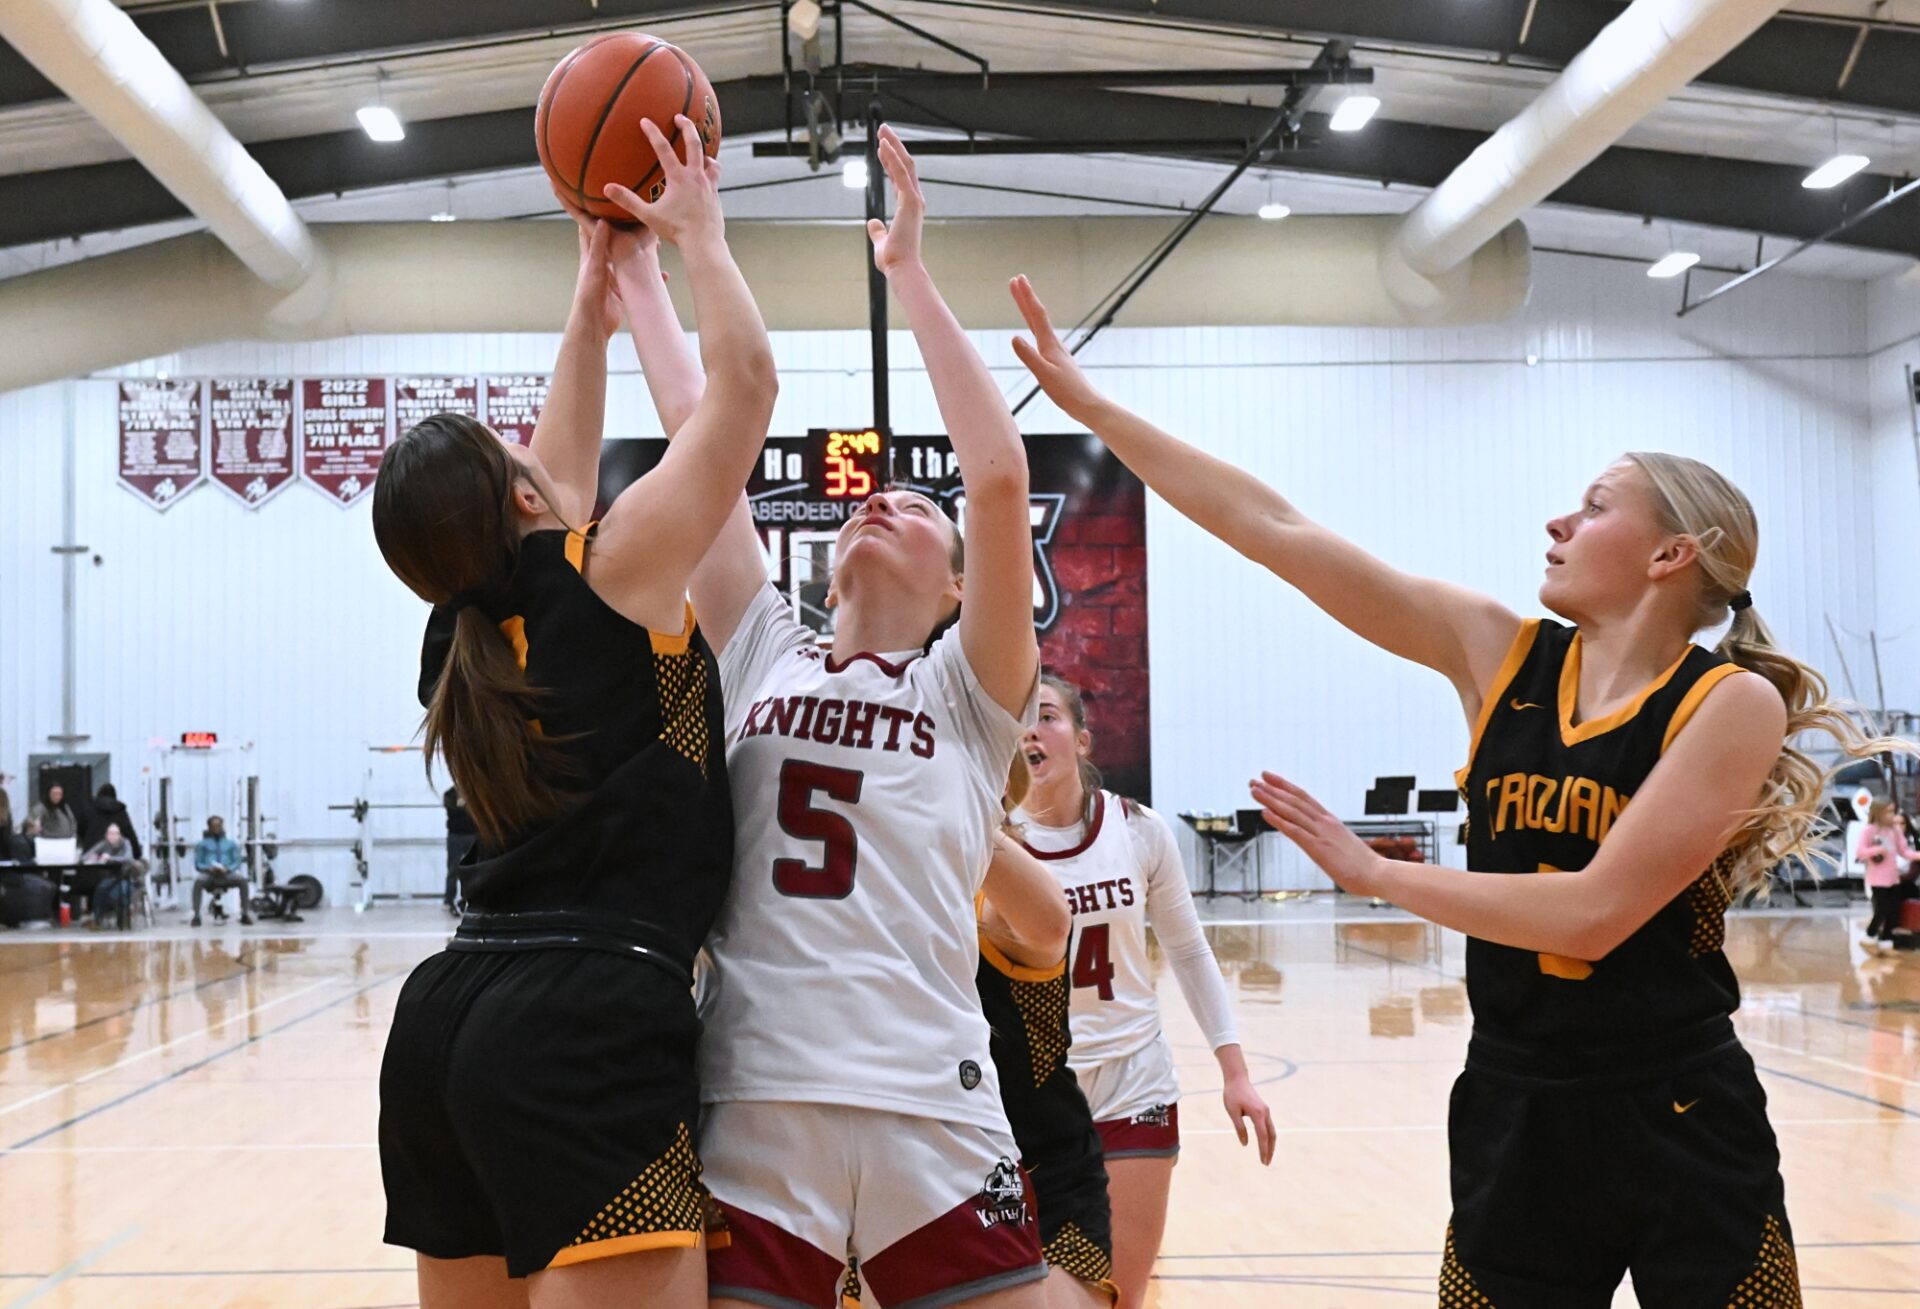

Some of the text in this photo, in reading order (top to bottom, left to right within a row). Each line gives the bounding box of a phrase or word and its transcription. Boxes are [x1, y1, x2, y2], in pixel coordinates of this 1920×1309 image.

[320, 380, 369, 393] 2022
[321, 393, 367, 407] GIRLS
[416, 389, 456, 398] BOYS
[212, 400, 290, 410] BASKETBALL
[397, 399, 474, 409] BASKETBALL
[212, 410, 257, 420] STATE
[304, 408, 385, 421] CROSS COUNTRY
[304, 422, 350, 435] STATE
[337, 434, 381, 447] PLACE
[826, 432, 880, 457] 2:49
[751, 501, 844, 521] ABERDEEN
[737, 696, 936, 759] KNIGHTS
[1485, 772, 1631, 847] TROJAN
[772, 758, 864, 900] 5
[1064, 877, 1135, 916] GHTS
